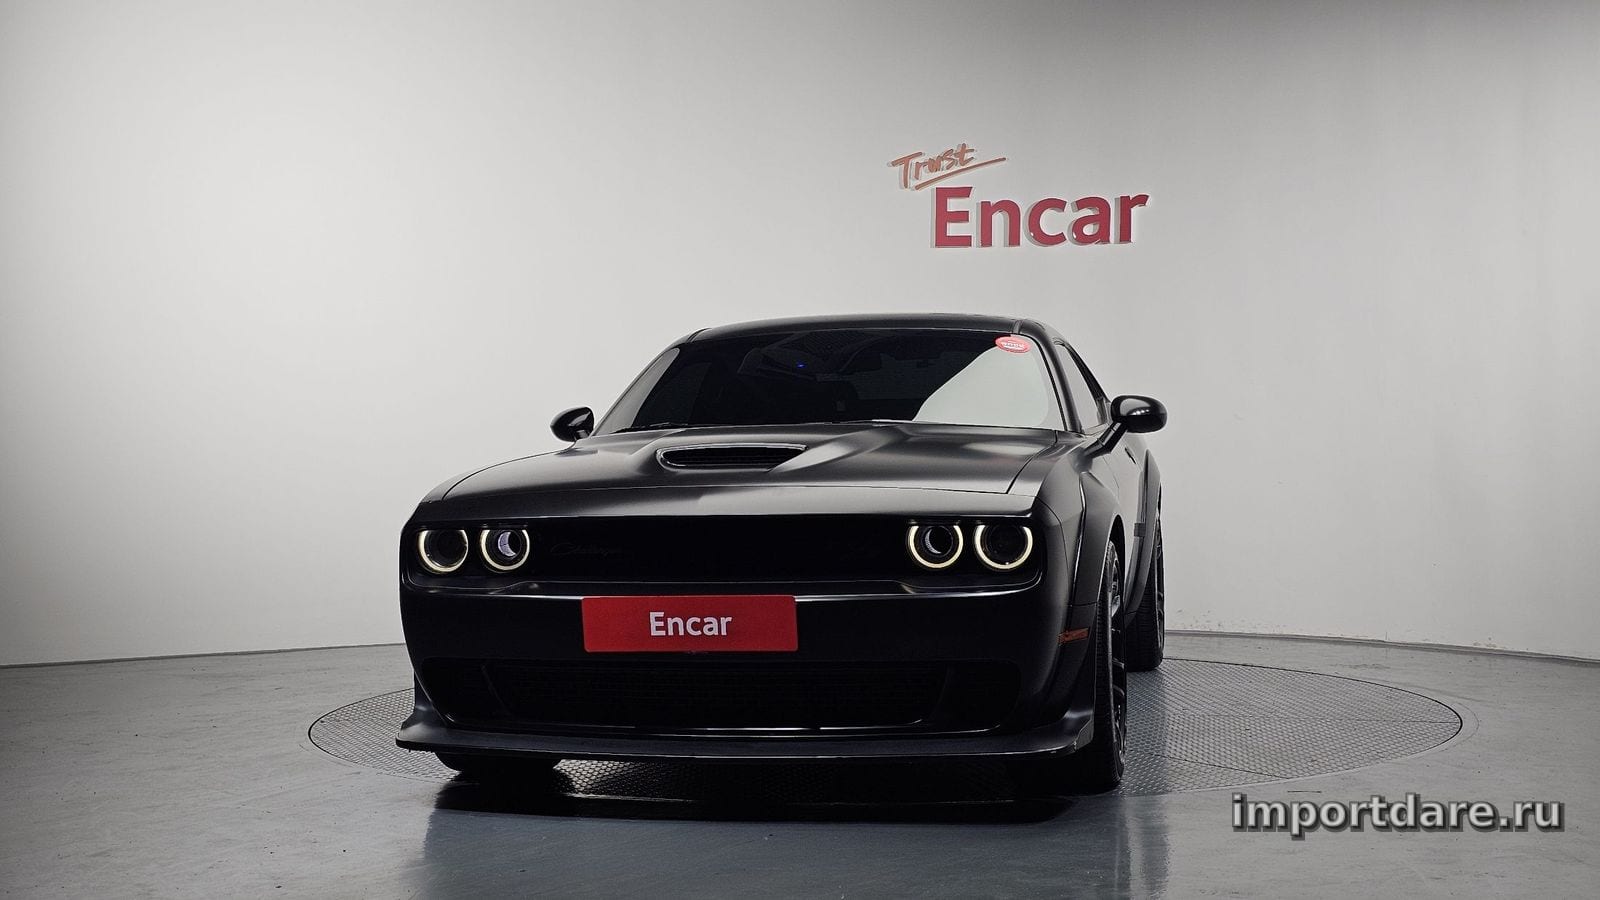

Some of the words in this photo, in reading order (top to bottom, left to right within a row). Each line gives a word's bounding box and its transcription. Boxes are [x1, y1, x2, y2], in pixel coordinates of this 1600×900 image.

[890, 143, 976, 189] Trust
[933, 186, 1150, 248] Encar
[649, 611, 732, 636] Encar
